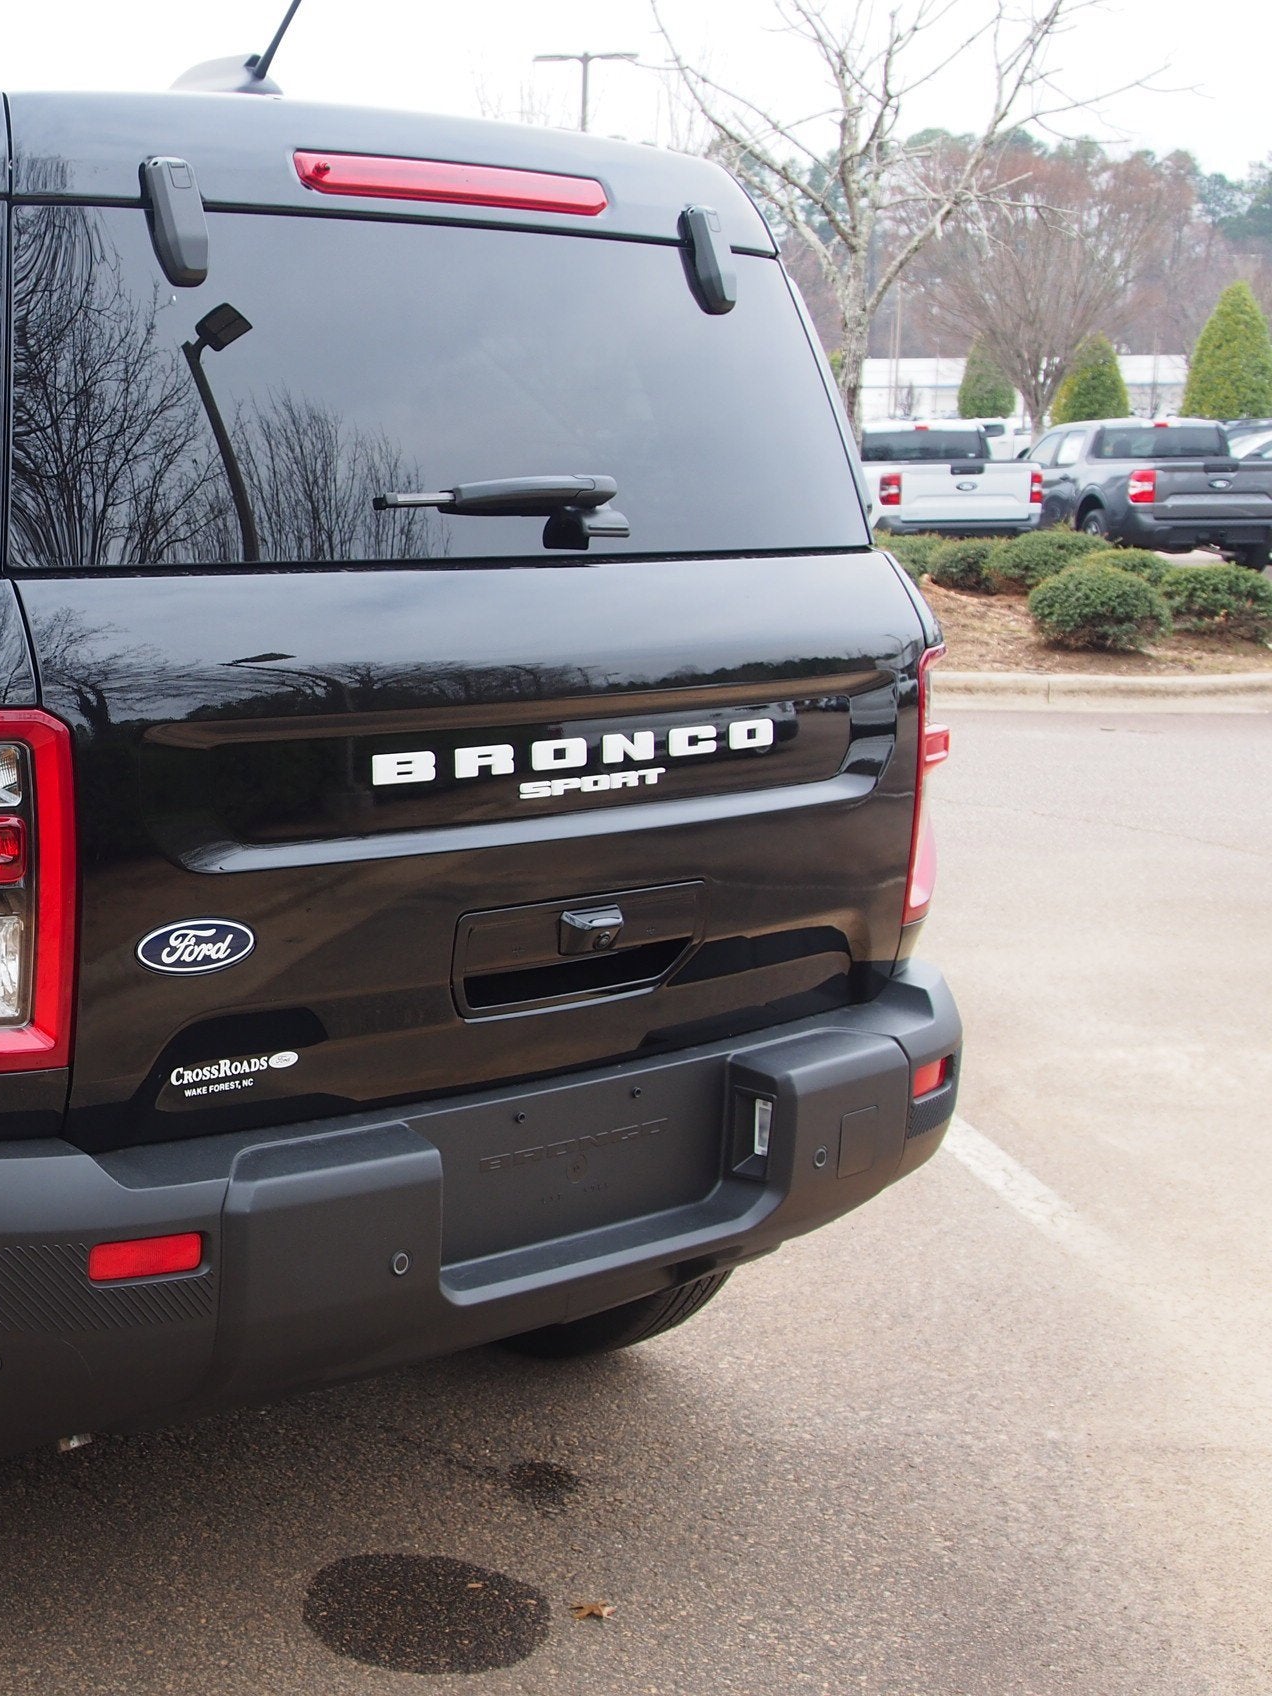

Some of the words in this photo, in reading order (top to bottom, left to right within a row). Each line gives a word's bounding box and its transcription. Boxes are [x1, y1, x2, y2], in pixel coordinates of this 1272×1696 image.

[371, 718, 775, 786] BRONCO
[519, 766, 666, 800] SPORT
[161, 928, 234, 964] Ford
[184, 1086, 208, 1098] WAKE
[242, 1078, 254, 1088] NC
